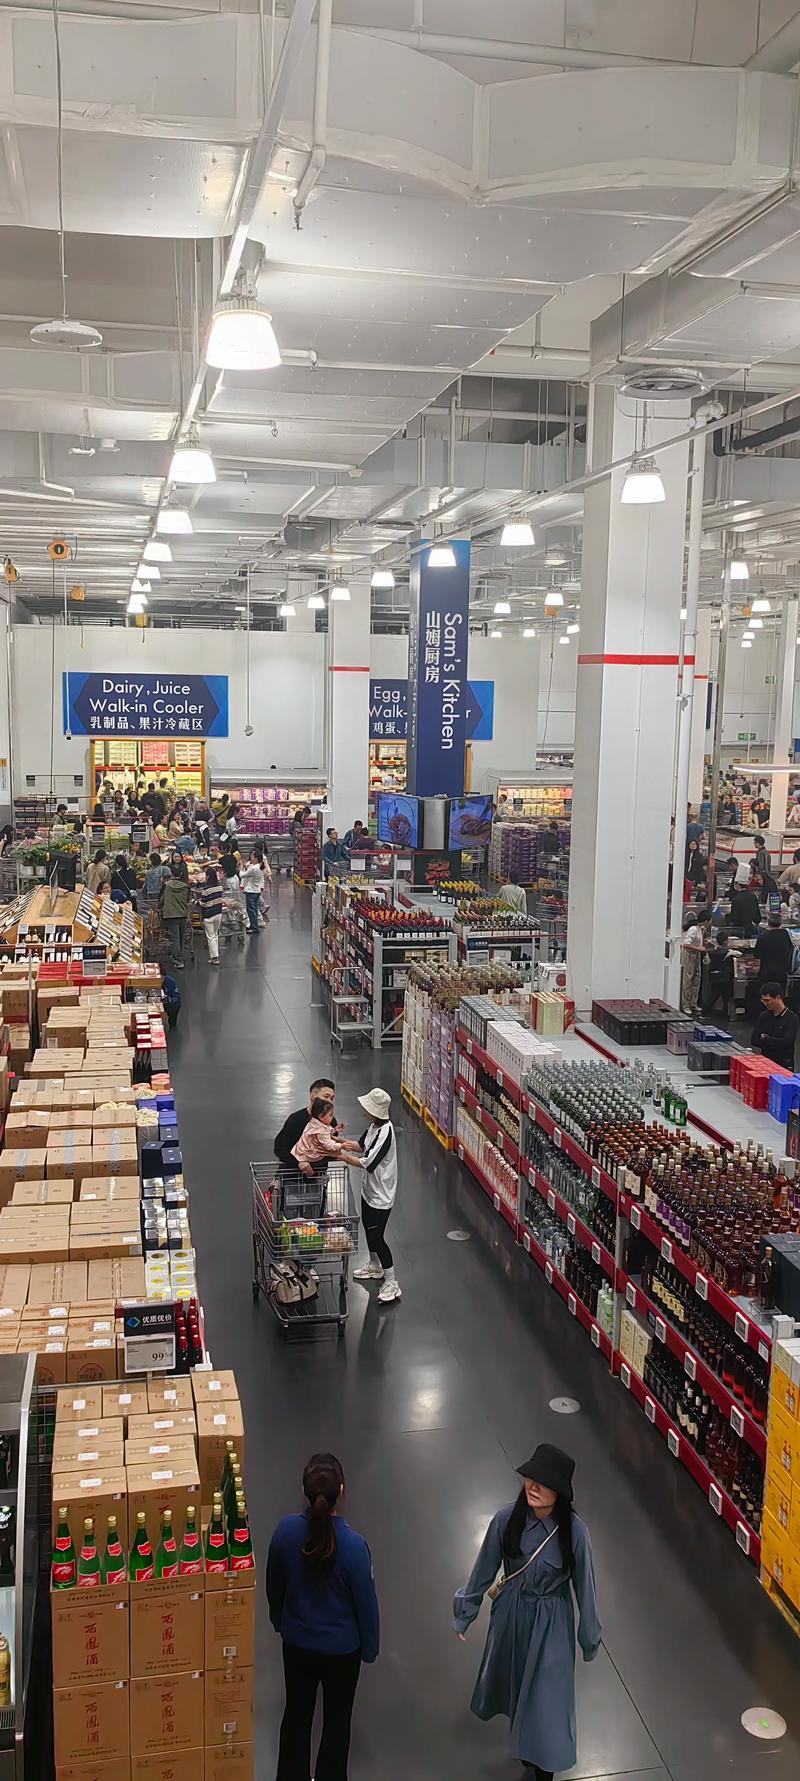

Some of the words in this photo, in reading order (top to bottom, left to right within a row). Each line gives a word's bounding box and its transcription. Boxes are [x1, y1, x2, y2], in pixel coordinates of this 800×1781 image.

[425, 610, 440, 684] 山姆厨房
[443, 612, 463, 672] Sam's
[152, 680, 191, 695] Juice
[373, 686, 406, 703] Egg,
[89, 698, 148, 713] Walk-in
[153, 699, 204, 714] Cooler
[369, 704, 408, 718] Walk-
[441, 679, 461, 750] Kitchen
[90, 716, 204, 731] 乳制品、果汁冷藏区
[372, 721, 408, 735] 鸡蛋、
[142, 1313, 172, 1324] 优质优价
